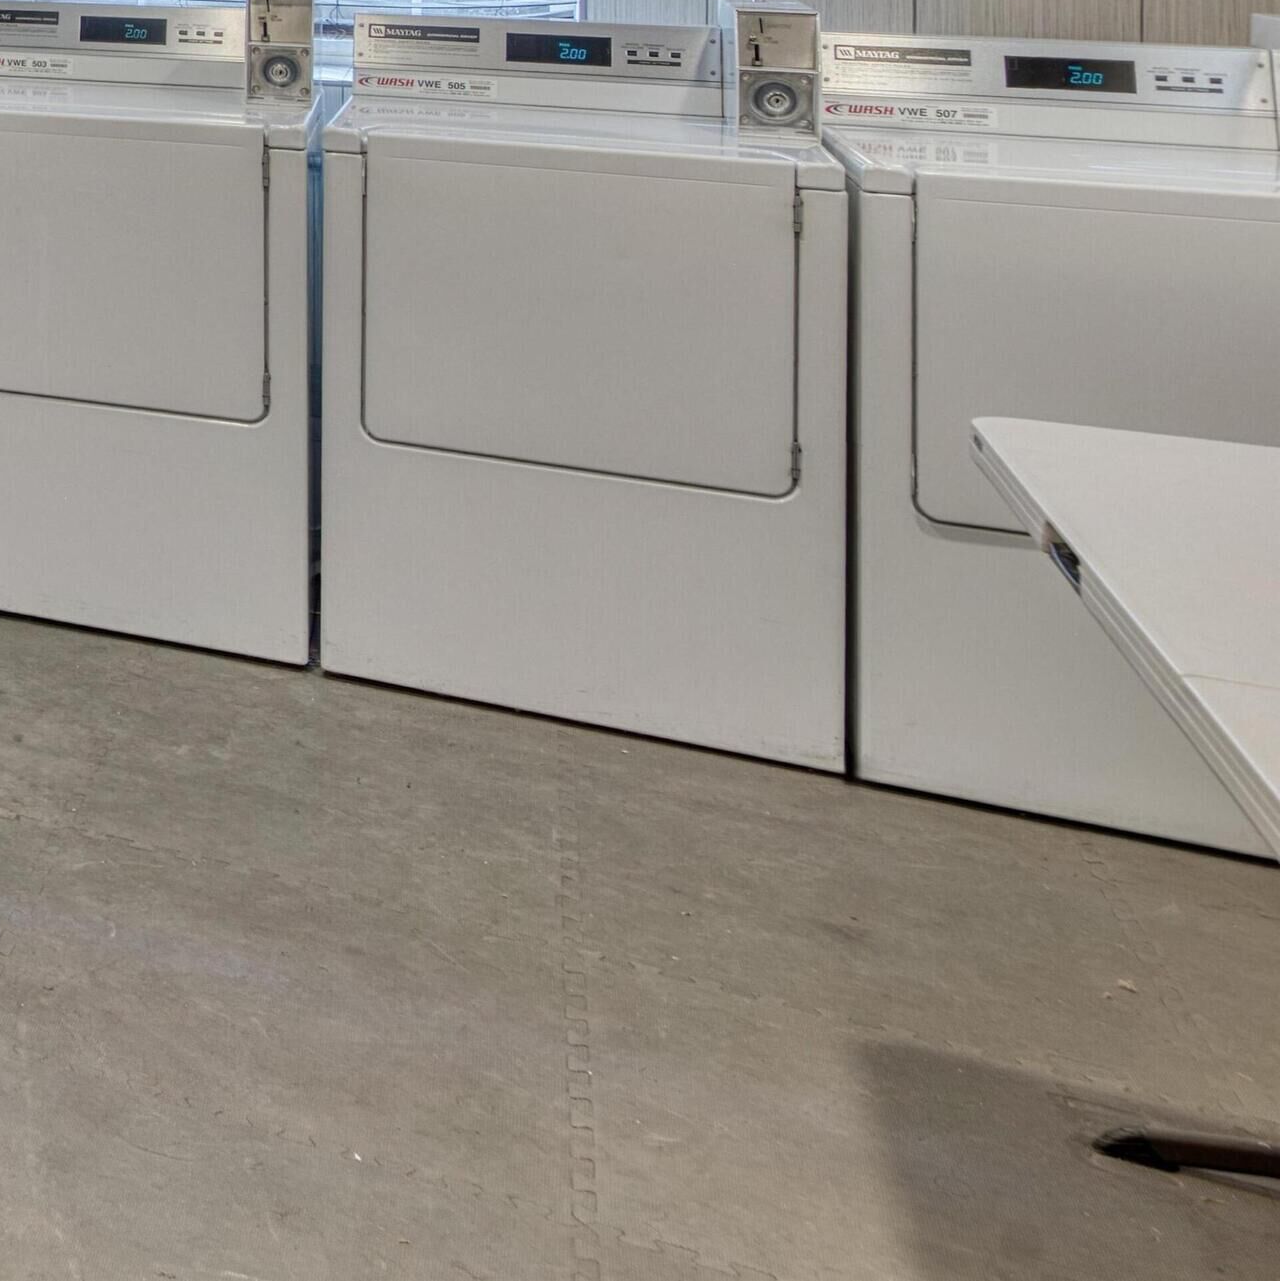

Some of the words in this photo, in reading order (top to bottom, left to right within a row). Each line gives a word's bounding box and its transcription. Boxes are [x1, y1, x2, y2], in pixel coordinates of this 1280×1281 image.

[125, 28, 148, 39] 2.00
[385, 28, 422, 37] MAYTAG
[559, 47, 586, 60] 2.00
[855, 49, 900, 59] MAYTAG
[7, 59, 27, 67] VWE
[31, 60, 47, 68] 503
[376, 77, 415, 88] WASH
[417, 79, 442, 89] VWE
[447, 81, 466, 90] 505
[1069, 71, 1104, 85] 2.00
[847, 104, 894, 116] WASH
[898, 107, 928, 117] VWE
[935, 109, 958, 118] 507
